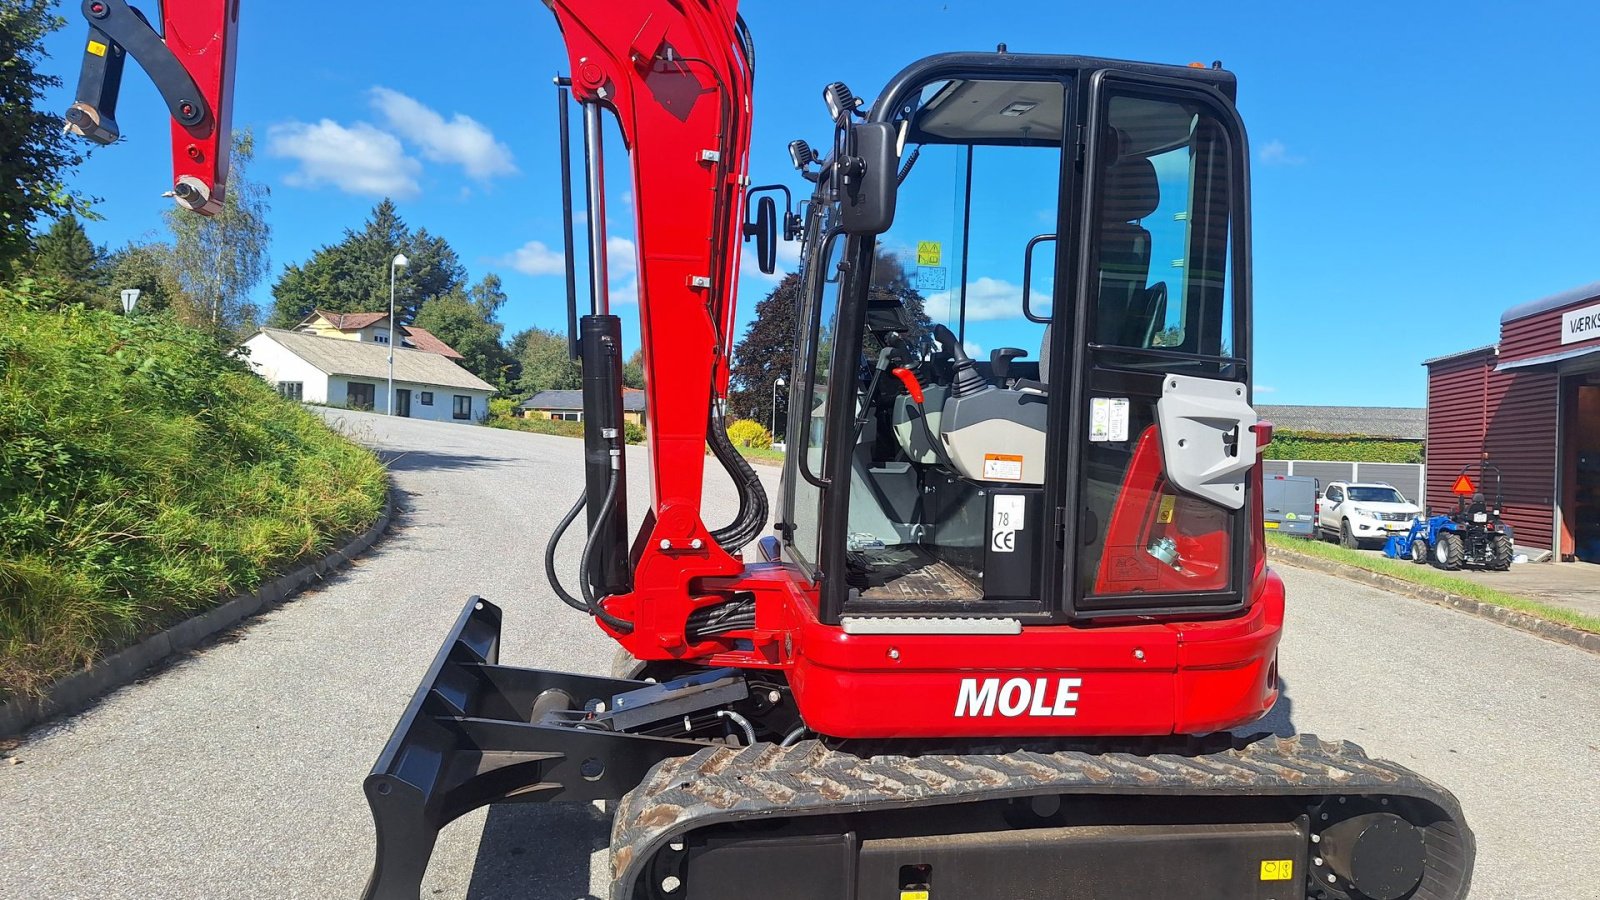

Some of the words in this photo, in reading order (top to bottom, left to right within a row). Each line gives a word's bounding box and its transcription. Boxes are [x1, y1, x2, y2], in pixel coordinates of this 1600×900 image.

[997, 512, 1009, 526] 78
[994, 531, 1014, 550] CE
[954, 677, 1082, 717] MOLE
